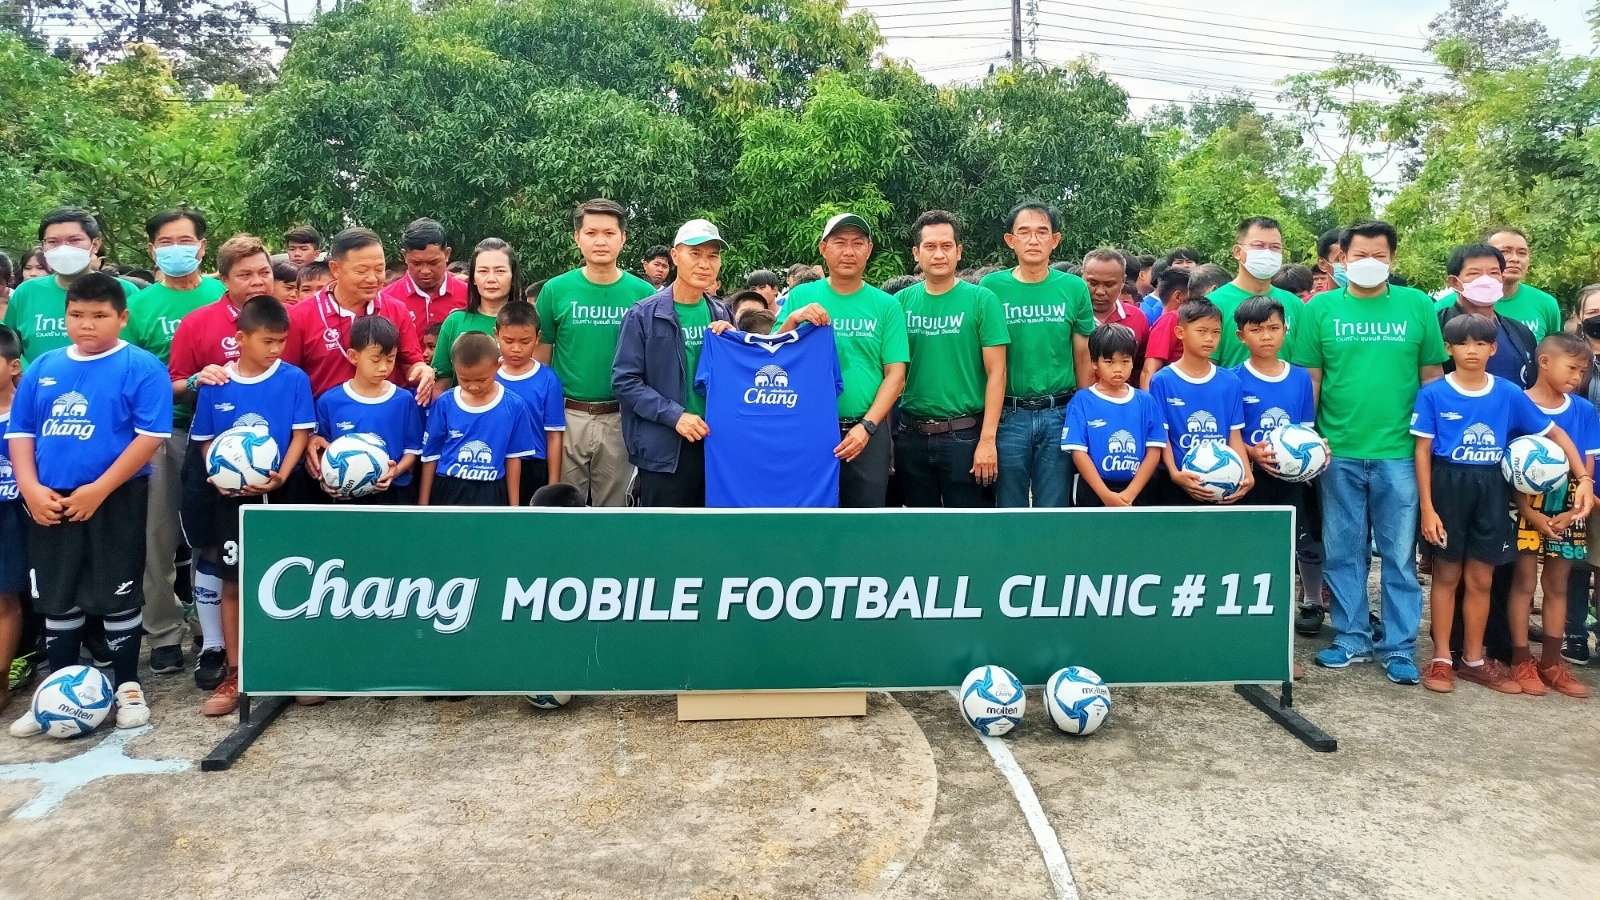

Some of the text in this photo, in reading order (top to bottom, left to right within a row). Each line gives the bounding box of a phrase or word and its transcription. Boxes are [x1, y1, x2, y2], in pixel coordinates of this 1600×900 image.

[833, 318, 878, 332] ยเบฟ
[1333, 319, 1408, 337] ไทยเบฟ
[743, 387, 799, 409] Chang
[41, 418, 96, 440] Chang
[222, 540, 238, 566] 3
[257, 555, 481, 634] Chang
[501, 577, 704, 622] MOBILE
[717, 576, 983, 621] FOOTBALL
[998, 574, 1161, 618] CLINIC
[1171, 574, 1207, 617] #
[1215, 573, 1275, 616] 11
[58, 703, 94, 721] molten
[986, 705, 1018, 715] molten
